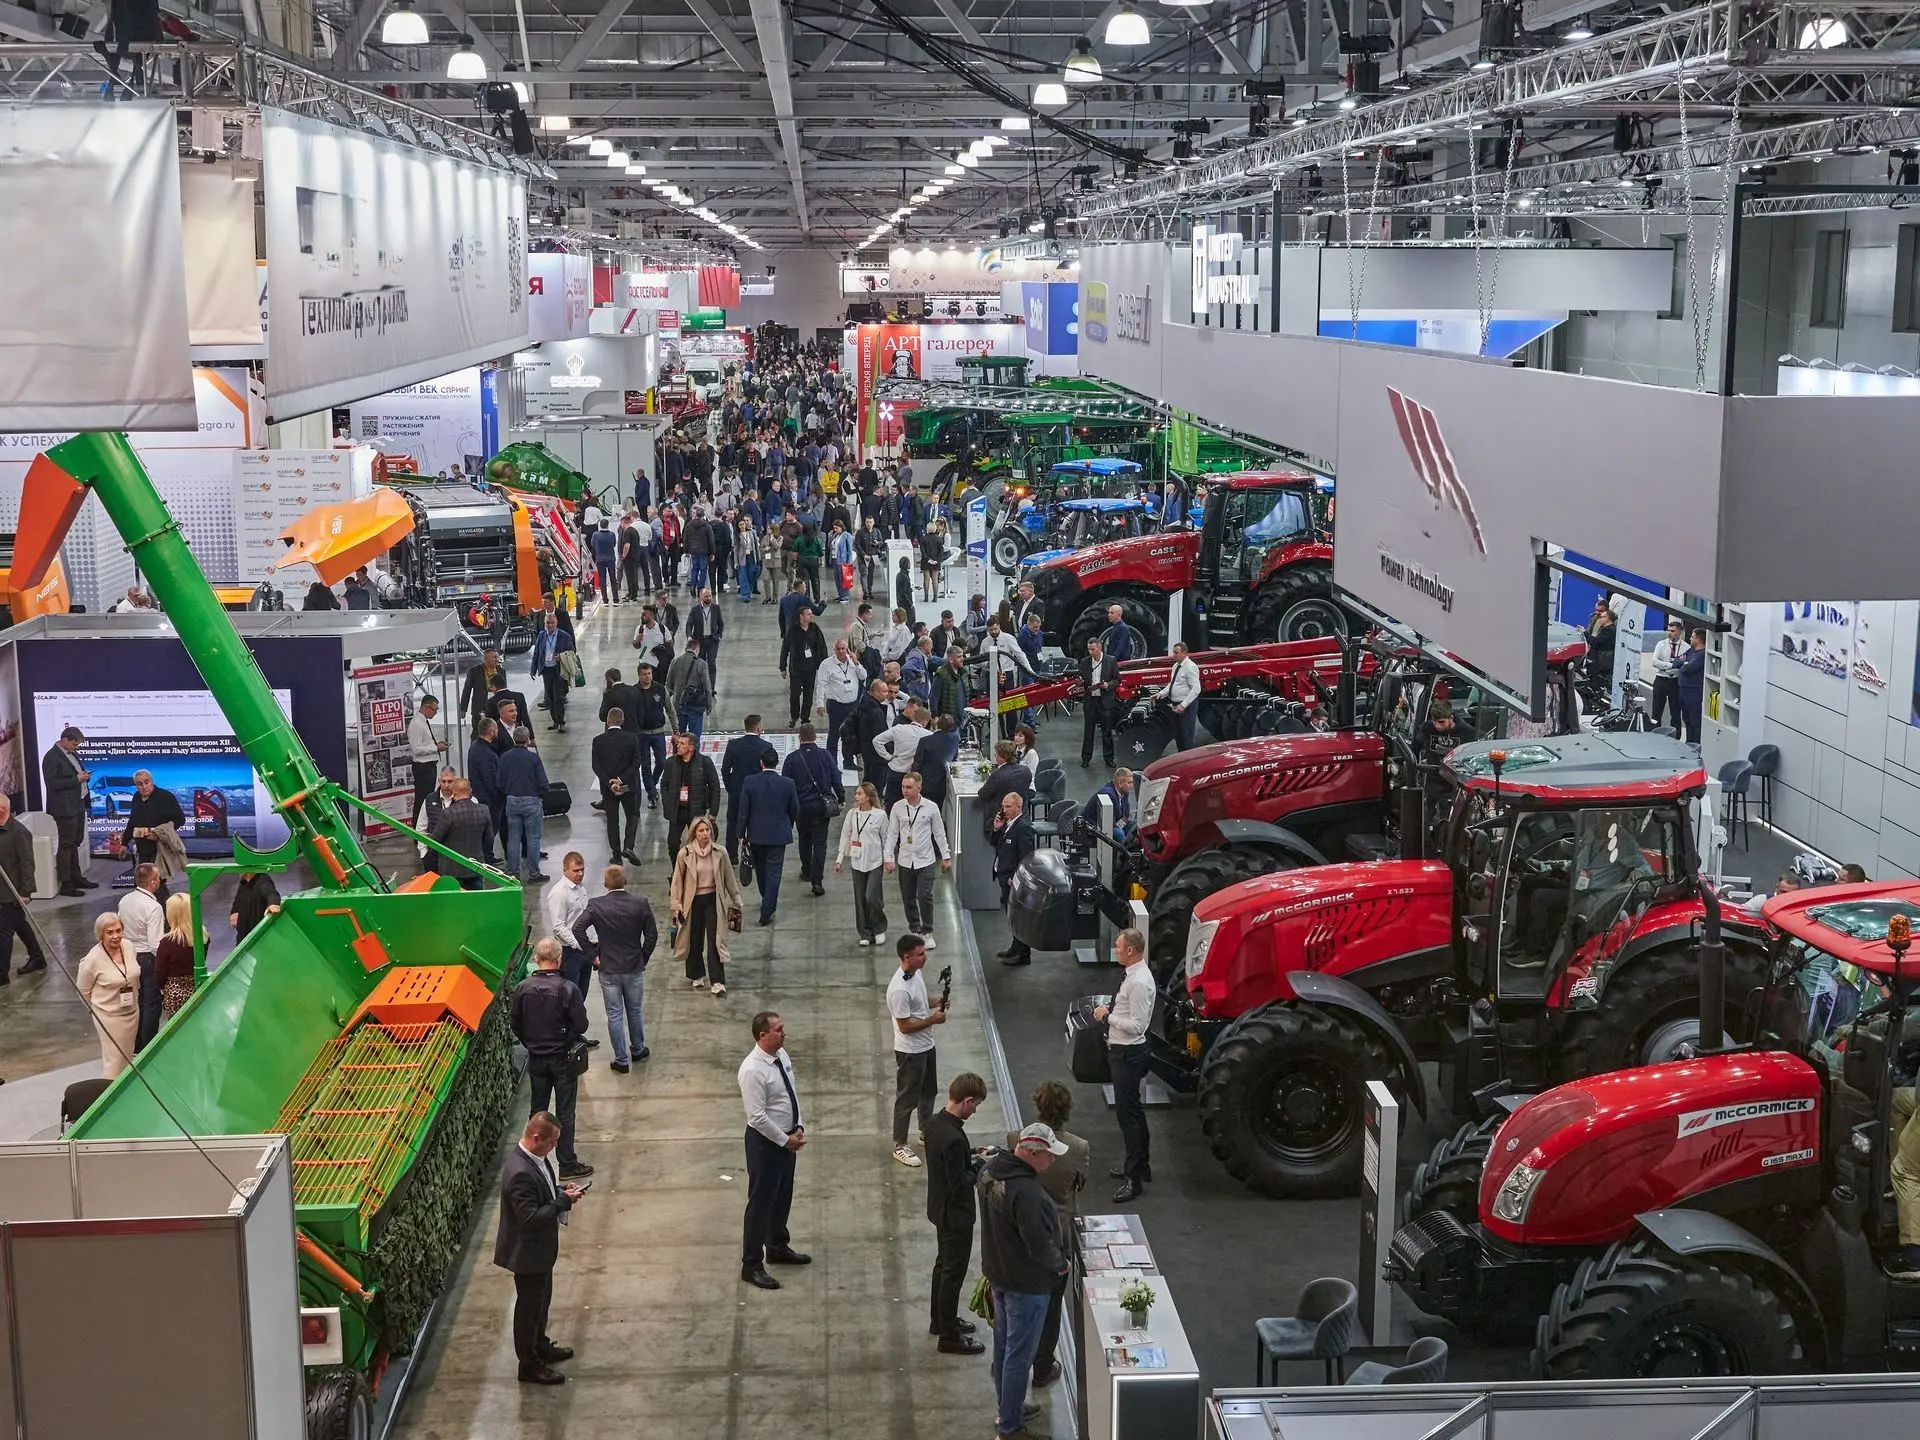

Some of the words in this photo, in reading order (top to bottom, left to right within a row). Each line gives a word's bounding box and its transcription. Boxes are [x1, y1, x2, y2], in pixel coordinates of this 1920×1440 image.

[1208, 275, 1251, 305] INDUSTRIAL
[884, 336, 922, 351] АРТ
[927, 339, 995, 354] галерея
[864, 336, 872, 369] ВПЕРЕД
[419, 385, 437, 394] ВЕК
[440, 386, 470, 394] СПРИНГ
[864, 370, 872, 398] ВРЕМЯ
[1150, 546, 1176, 556] CASE
[1380, 554, 1404, 582] Power
[1406, 566, 1455, 614] Technology
[374, 701, 401, 714] АГРО
[126, 740, 178, 749] официальным
[179, 739, 218, 748] партнером
[127, 748, 161, 756] Скорости
[171, 747, 189, 755] Льду
[1770, 1156, 1784, 1164] 165
